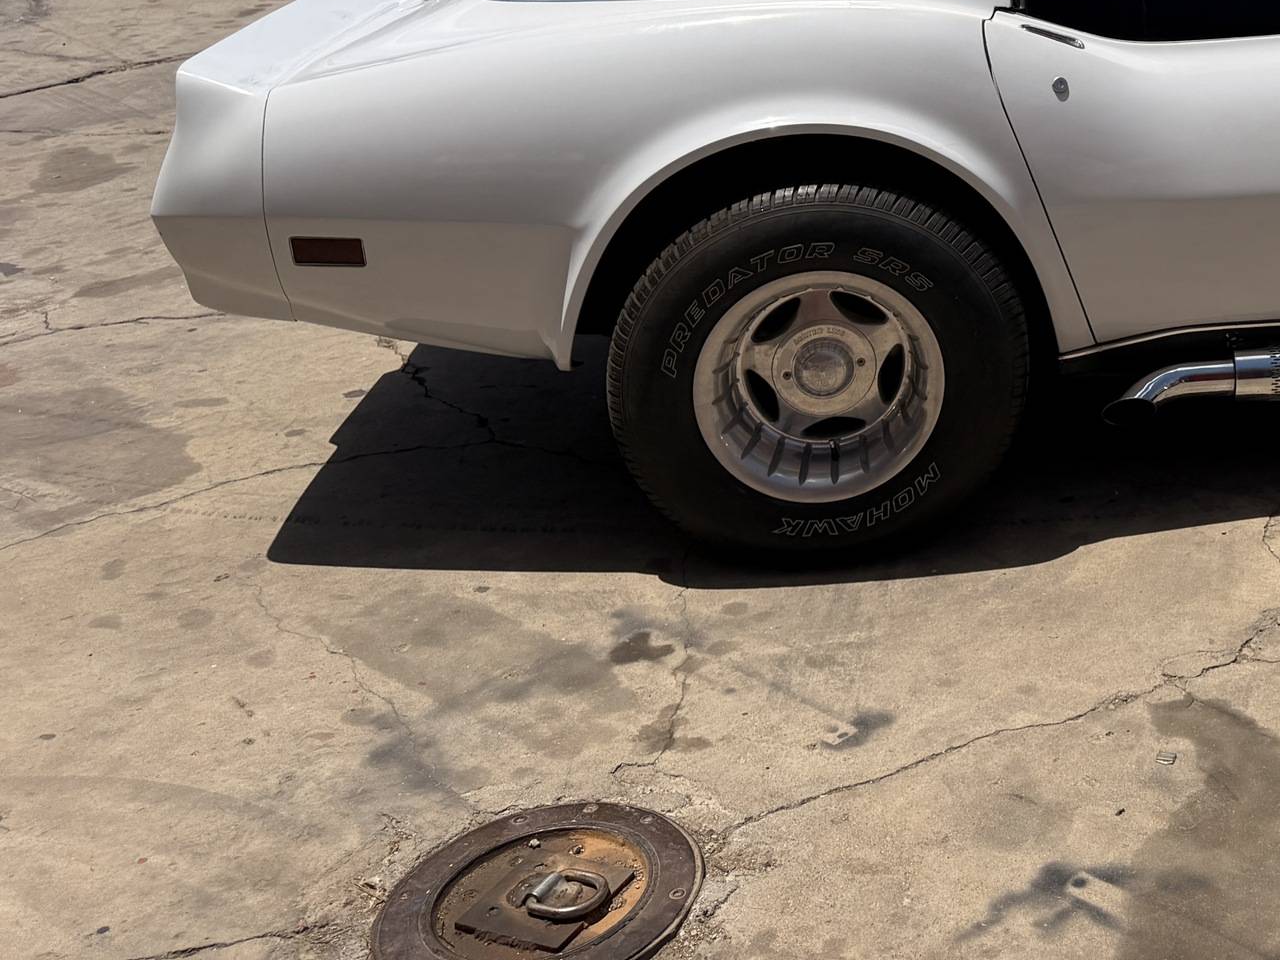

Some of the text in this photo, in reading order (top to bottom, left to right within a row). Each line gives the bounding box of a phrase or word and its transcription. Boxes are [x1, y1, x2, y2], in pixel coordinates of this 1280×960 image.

[660, 242, 934, 378] PREDATOR SRS
[772, 462, 941, 537] MOHAWK
